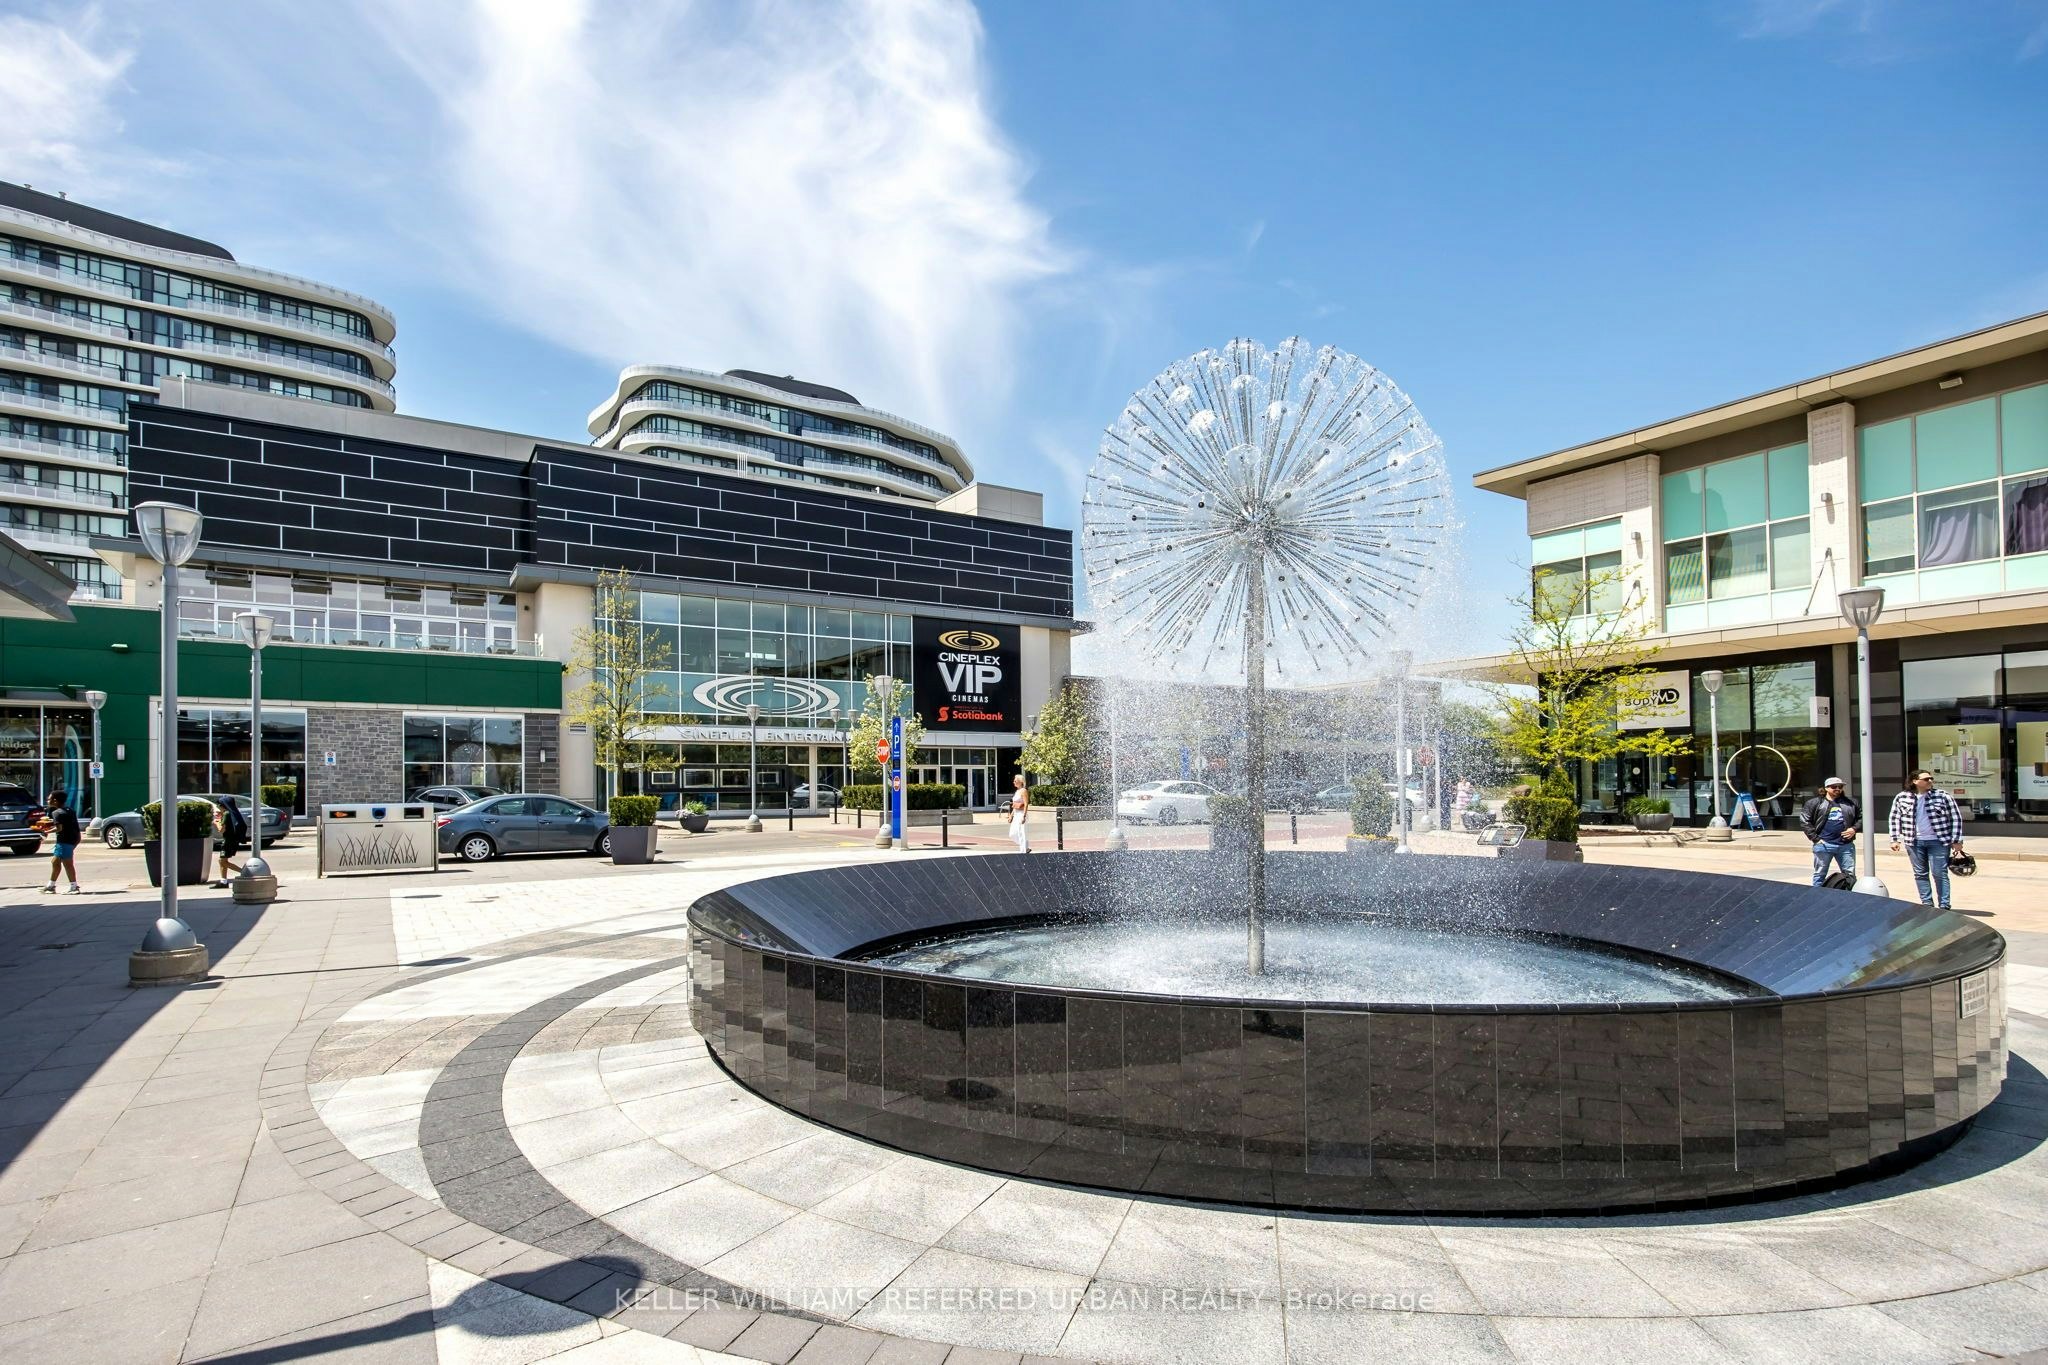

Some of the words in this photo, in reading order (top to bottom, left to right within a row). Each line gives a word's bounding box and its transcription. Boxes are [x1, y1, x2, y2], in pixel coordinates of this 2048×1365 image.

[939, 652, 1000, 666] CINEPLEX
[937, 662, 1003, 694] VIP
[952, 694, 989, 703] CINEMAS
[952, 710, 1003, 721] Scotiabank
[894, 735, 900, 749] P
